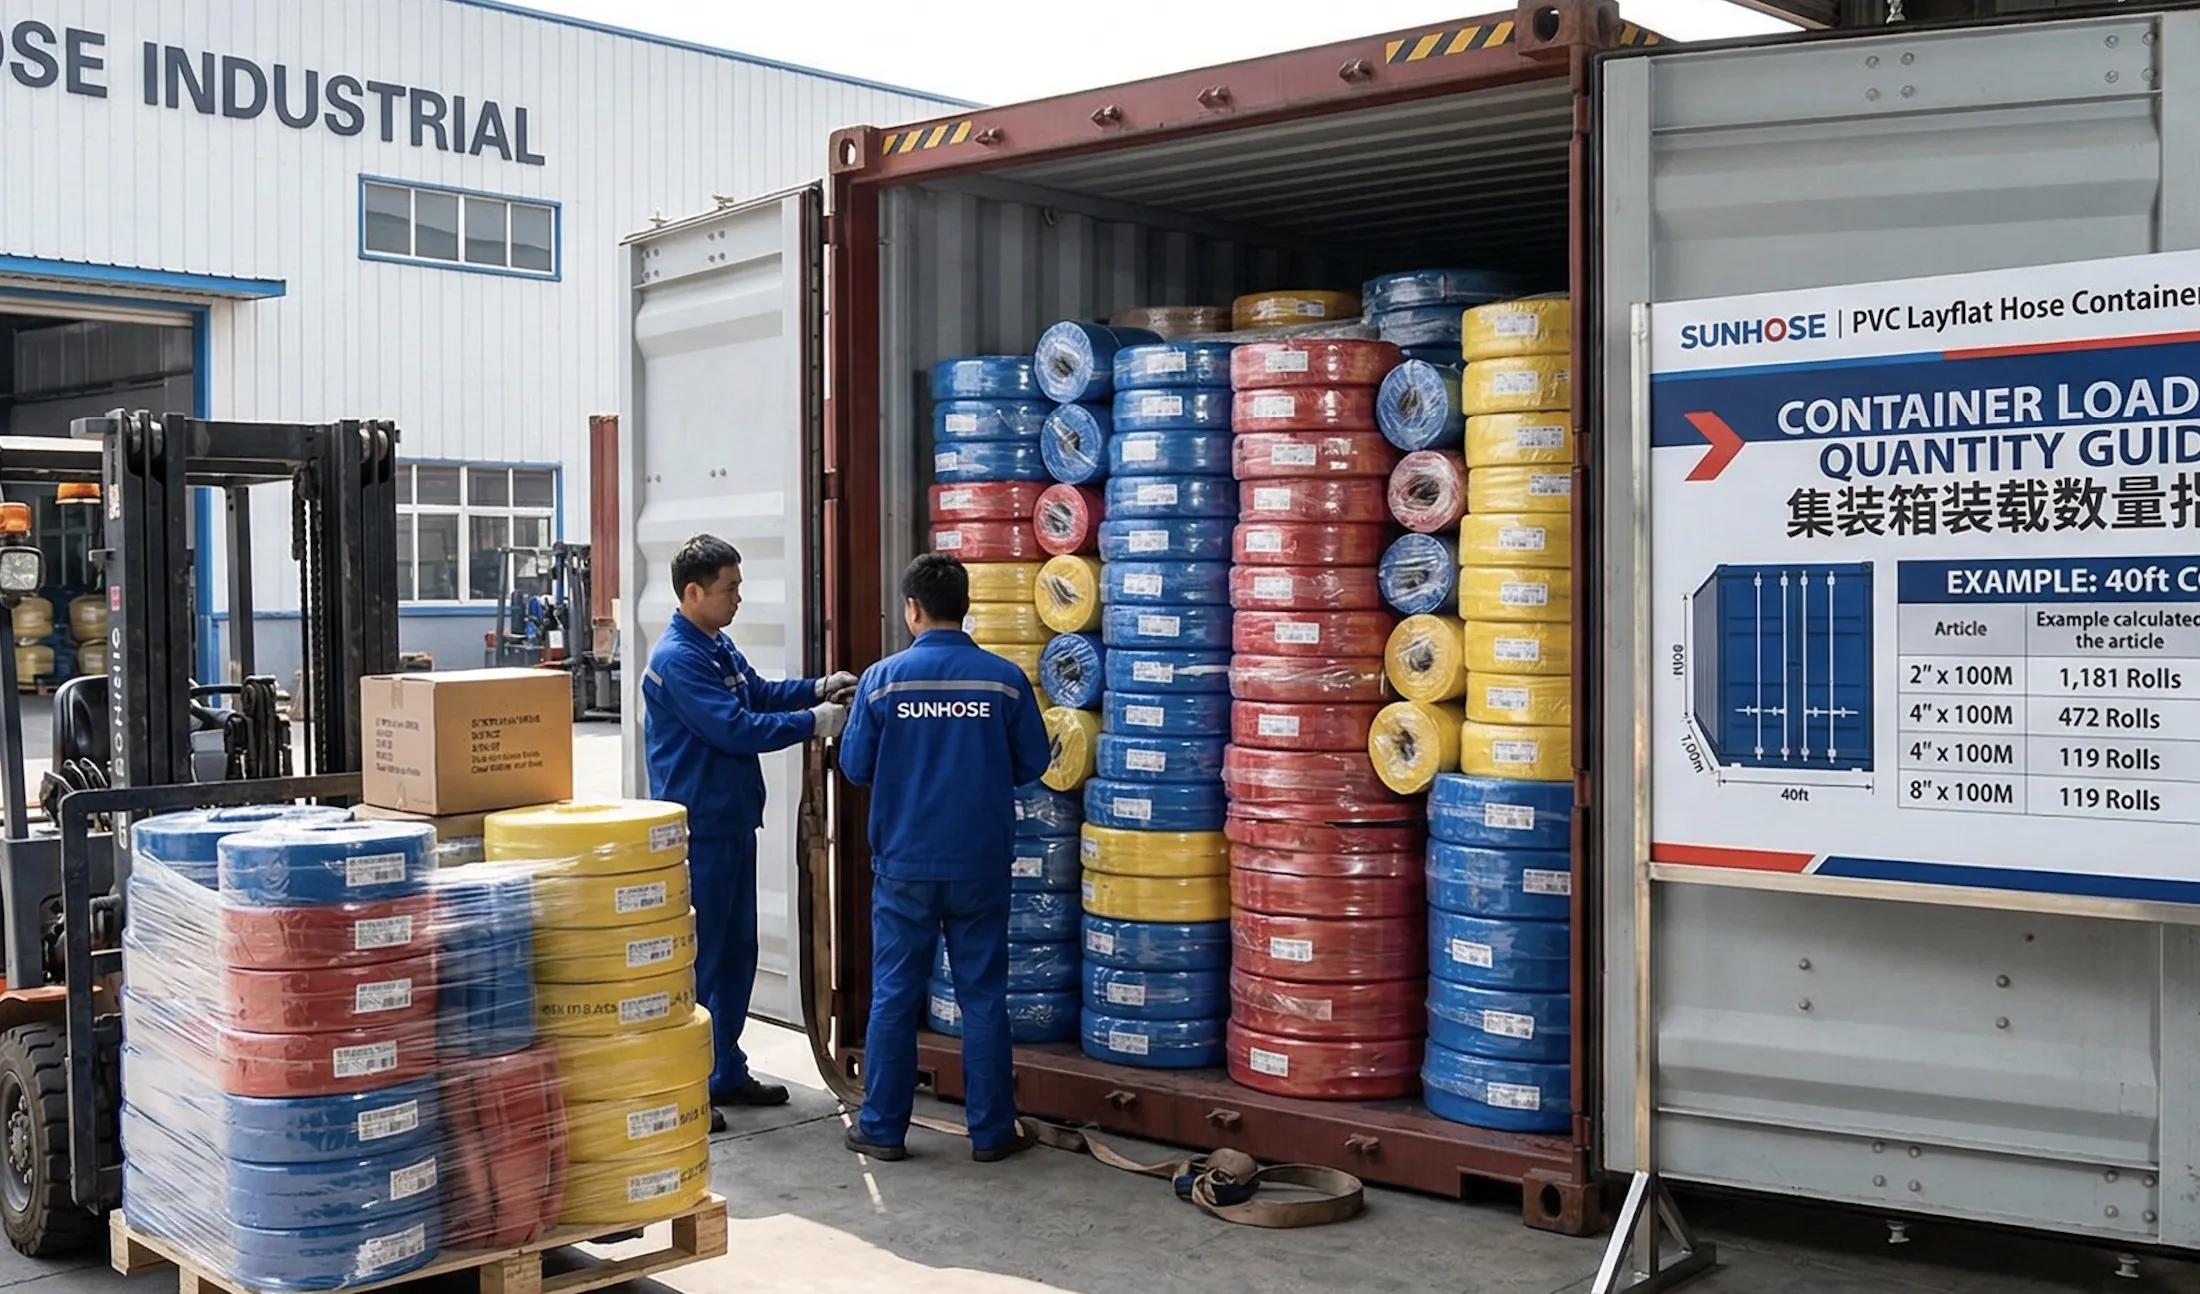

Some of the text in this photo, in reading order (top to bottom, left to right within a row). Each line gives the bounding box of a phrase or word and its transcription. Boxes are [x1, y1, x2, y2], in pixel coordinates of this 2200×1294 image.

[0, 20, 545, 166] SE INDUSTRIAL
[1681, 284, 2200, 349] SUNHOSE PVC Layflat Hose Containe
[1777, 376, 2199, 435] CONTAINER LOAD
[1819, 432, 2065, 482] QUANTITY
[1948, 566, 2200, 594] EXAMPLE: 40ft C
[1935, 621, 1987, 636] Article
[2037, 611, 2109, 630] Example
[2076, 634, 2165, 649] the article
[1909, 664, 2013, 685] 2" x 100M
[2060, 668, 2181, 690] 1,181 Rolls
[897, 701, 990, 719] SUNHOSE
[1909, 703, 2013, 727] 4" x 100M
[2058, 707, 2160, 729] 472 Rolls
[1909, 741, 2013, 765] 4" x 100M
[2060, 748, 2160, 770] 119 Rolls
[1781, 788, 1809, 802] 40ft
[1909, 779, 2013, 804] 8" x 100M
[2060, 787, 2160, 809] 119 Rolls
